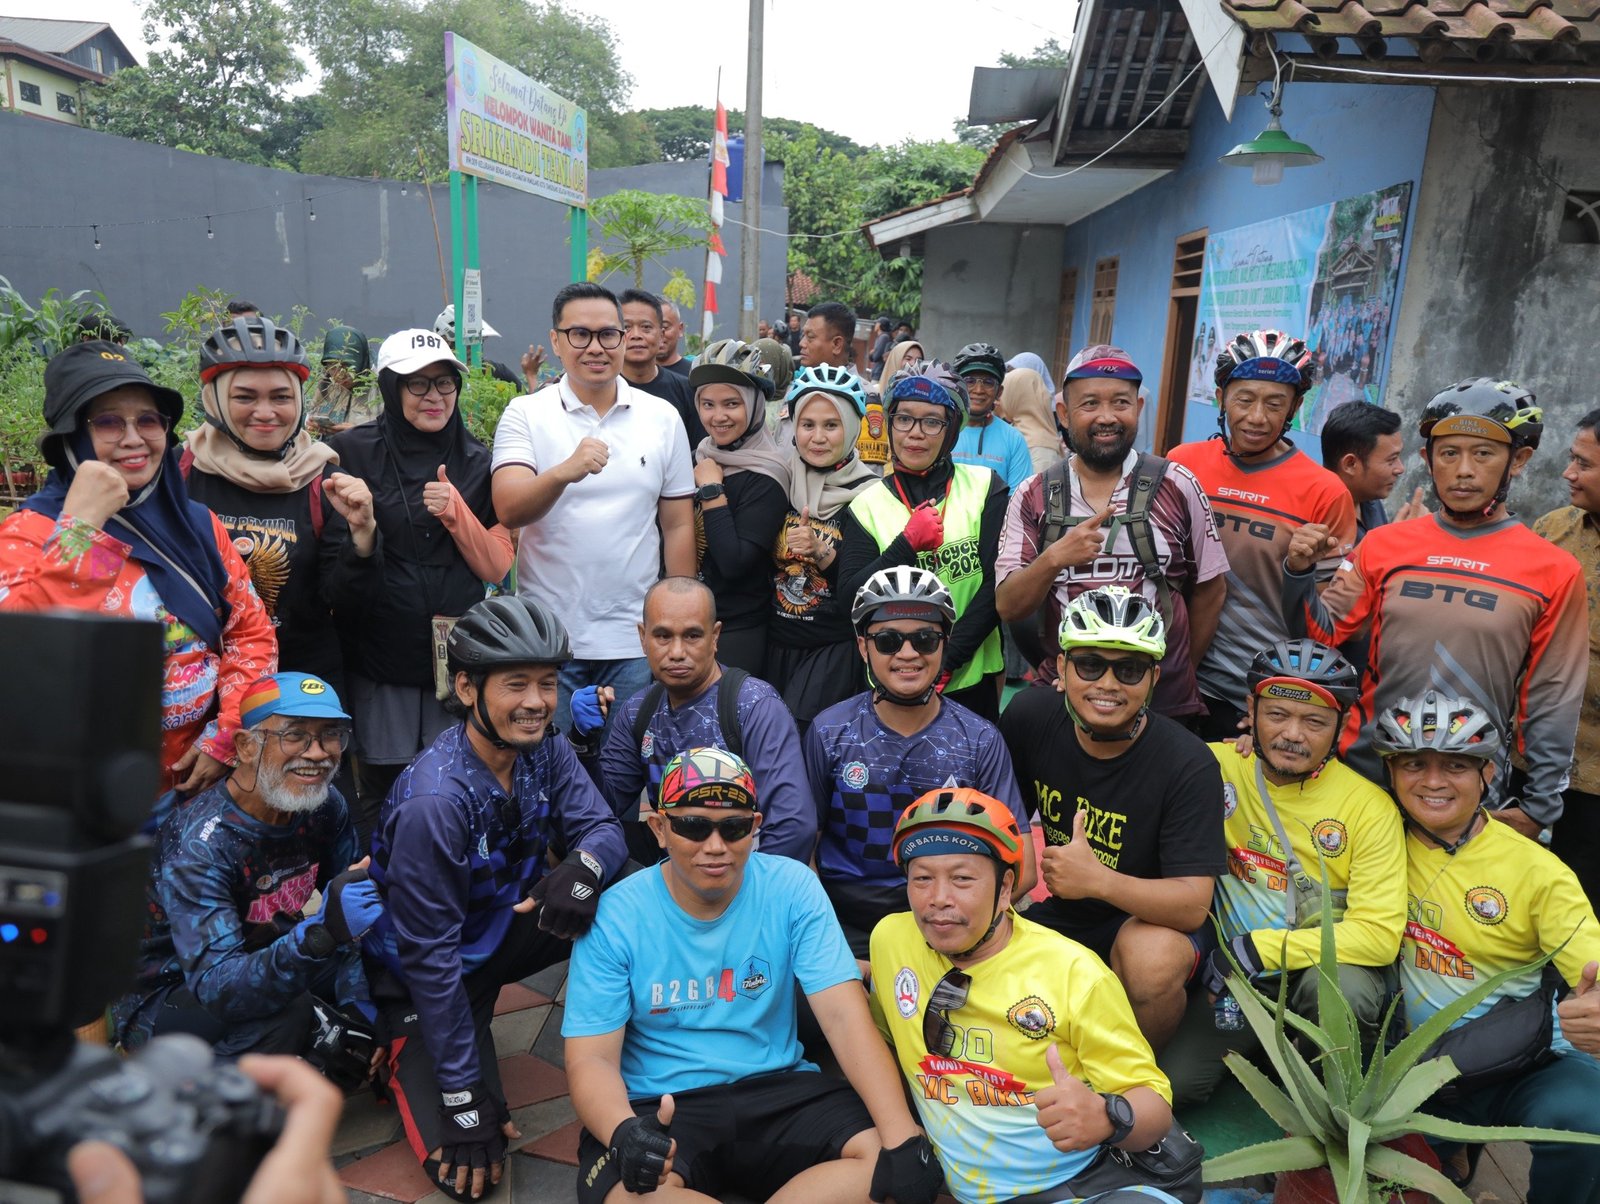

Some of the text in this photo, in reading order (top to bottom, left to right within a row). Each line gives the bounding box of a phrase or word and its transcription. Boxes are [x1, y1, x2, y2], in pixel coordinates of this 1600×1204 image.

[484, 95, 528, 132] KELOMPOK
[530, 115, 557, 145] WANITA
[460, 109, 541, 178] SRIKANDI
[541, 143, 572, 188] TANI
[411, 334, 441, 350] 1987
[1217, 486, 1270, 504] SPIRIT
[237, 516, 298, 543] PEMUDA
[1214, 511, 1277, 541] BTG
[1426, 555, 1490, 572] SPIRIT
[1399, 580, 1499, 611] BTG
[687, 785, 748, 805] FSR-23
[1034, 779, 1127, 851] MC BIKE
[904, 834, 979, 856] TUR BATAS KOTA
[1246, 824, 1288, 862] 30
[1414, 945, 1475, 981] BIKE
[915, 1074, 960, 1106] MC
